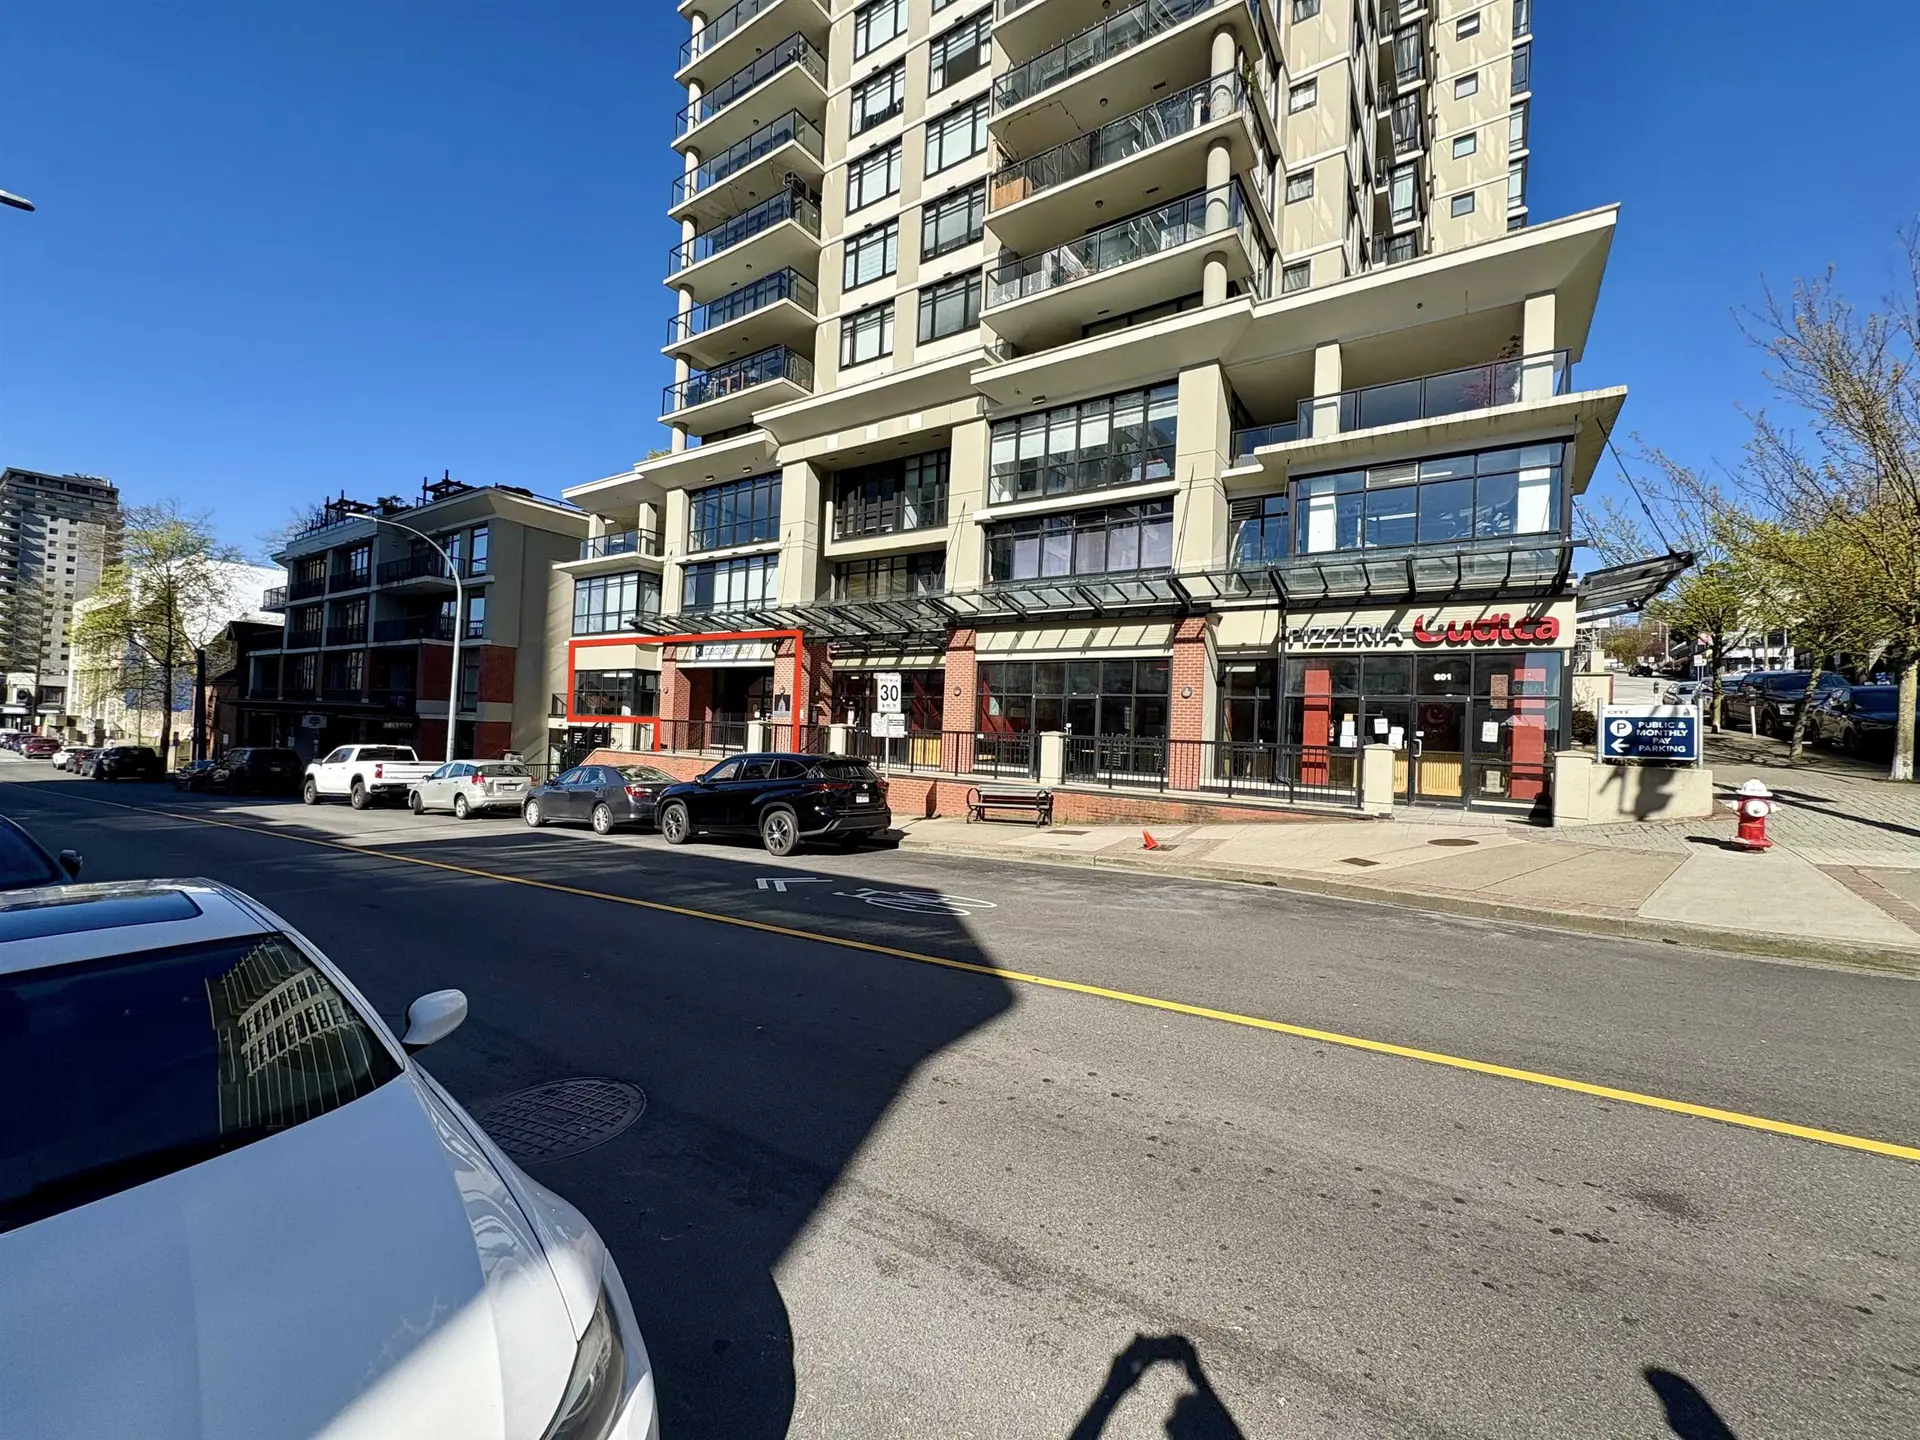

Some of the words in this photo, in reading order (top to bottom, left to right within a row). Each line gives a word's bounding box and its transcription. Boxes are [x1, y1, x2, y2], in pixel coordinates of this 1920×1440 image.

[1288, 623, 1404, 645] PIZZERIA
[1413, 613, 1560, 643] Ludica
[1433, 673, 1452, 681] 601
[880, 684, 899, 702] 30
[1616, 722, 1627, 734] P
[1638, 721, 1675, 729] PUBLIC
[1677, 721, 1686, 729] &
[1636, 729, 1688, 737] MONTHLY
[1652, 737, 1672, 745] PAY
[1638, 745, 1686, 753] PARKING
